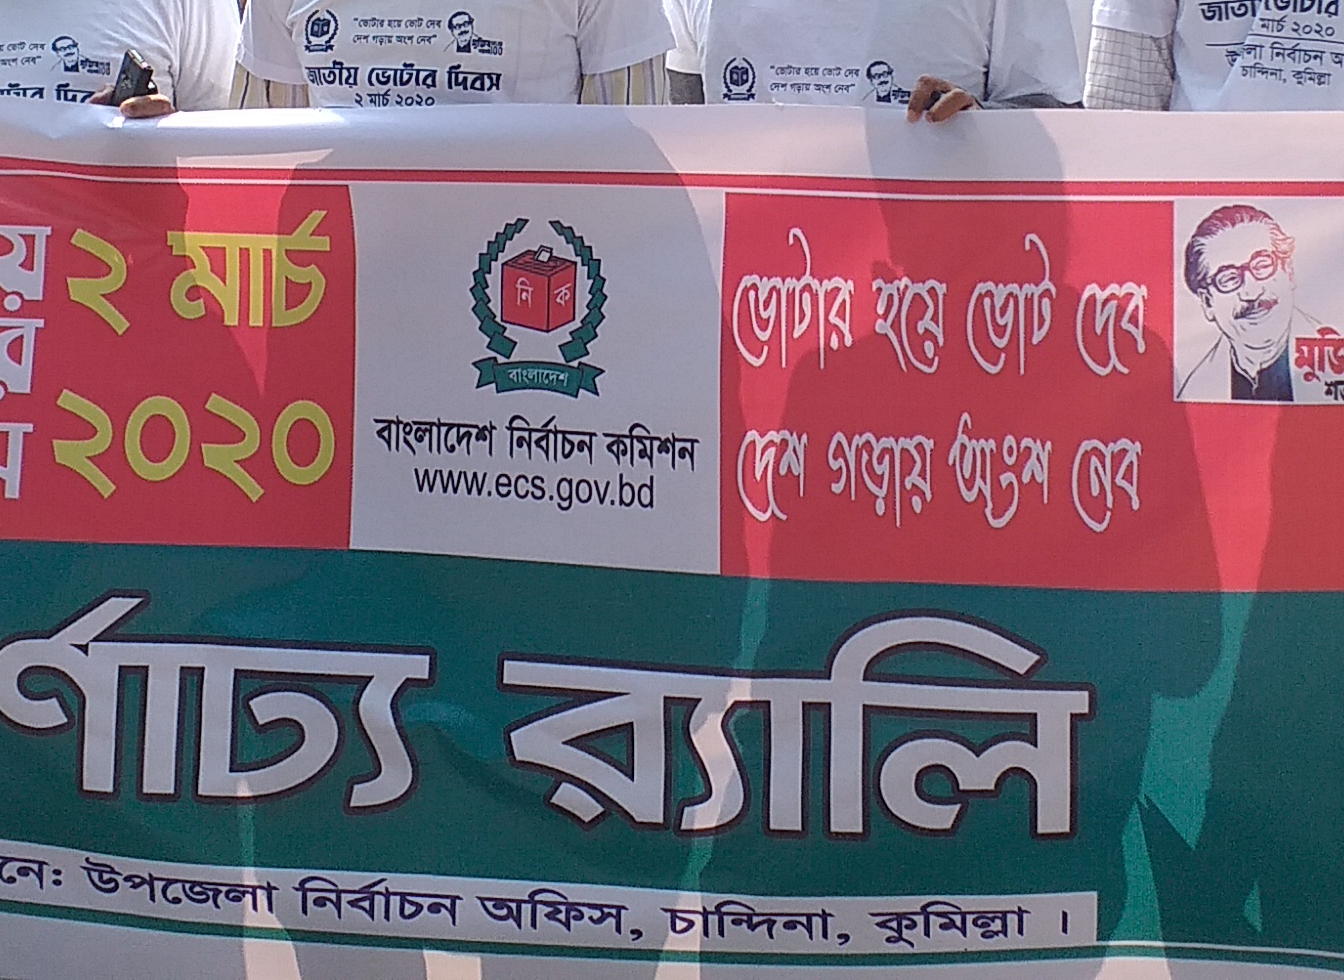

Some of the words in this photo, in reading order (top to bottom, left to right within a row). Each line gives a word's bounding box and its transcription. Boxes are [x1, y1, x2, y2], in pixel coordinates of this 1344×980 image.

[387, 18, 402, 28] হয়ে
[404, 17, 424, 28] ভোট
[425, 19, 442, 29] দেব
[1259, 15, 1288, 34] মার্চ
[1291, 21, 1336, 38] ২০২০
[6, 41, 27, 52] ভোট
[28, 42, 46, 52] দেব
[353, 34, 369, 44] দেশ
[372, 34, 393, 46] গড়ায়
[395, 34, 414, 45] অংশ
[0, 57, 20, 67] অংশ
[1269, 41, 1326, 67] নির্বাচন
[305, 59, 359, 89] জাতীয়
[367, 61, 438, 89] ভোটার
[447, 63, 502, 92] দিবস
[804, 66, 819, 77] হয়ে
[821, 66, 841, 77] ভোট
[844, 67, 860, 78] দেব
[1240, 62, 1288, 84] চান্দিনা,
[1291, 67, 1333, 87] কুমিল্লা
[354, 92, 364, 108] ২
[367, 88, 391, 108] মার্চ
[394, 93, 436, 108] ২০২০
[769, 82, 787, 92] দেশ
[789, 83, 811, 94] গড়ায়
[813, 83, 832, 94] অংশ
[66, 227, 131, 336] ২
[166, 210, 331, 328] মার্চ
[515, 277, 534, 308] নি
[554, 282, 571, 307] ক
[732, 227, 854, 368] ভোটার
[872, 277, 948, 374] হয়ে
[966, 233, 1057, 376] ভোট
[1075, 279, 1149, 377] দেব
[507, 366, 571, 388] বাংলাদেশ
[52, 388, 336, 503] ২০২০
[374, 414, 497, 457] বাংলাদেশ
[505, 414, 599, 466] নির্বাচন
[602, 422, 701, 472] কমিশন
[737, 429, 808, 522] দেশ
[828, 430, 935, 528] গড়ায়
[948, 412, 1052, 529] অংশ
[1071, 436, 1142, 533] নেব
[414, 466, 655, 512] www.ecs.gov.bd
[502, 614, 1091, 836] র‍্যালি
[83, 856, 279, 916] উপজেলা
[293, 876, 461, 927] নির্বাচন
[476, 888, 645, 942] অফিস,
[660, 900, 851, 947] চান্দিনা,
[869, 900, 1031, 948] কুমিল্লা
